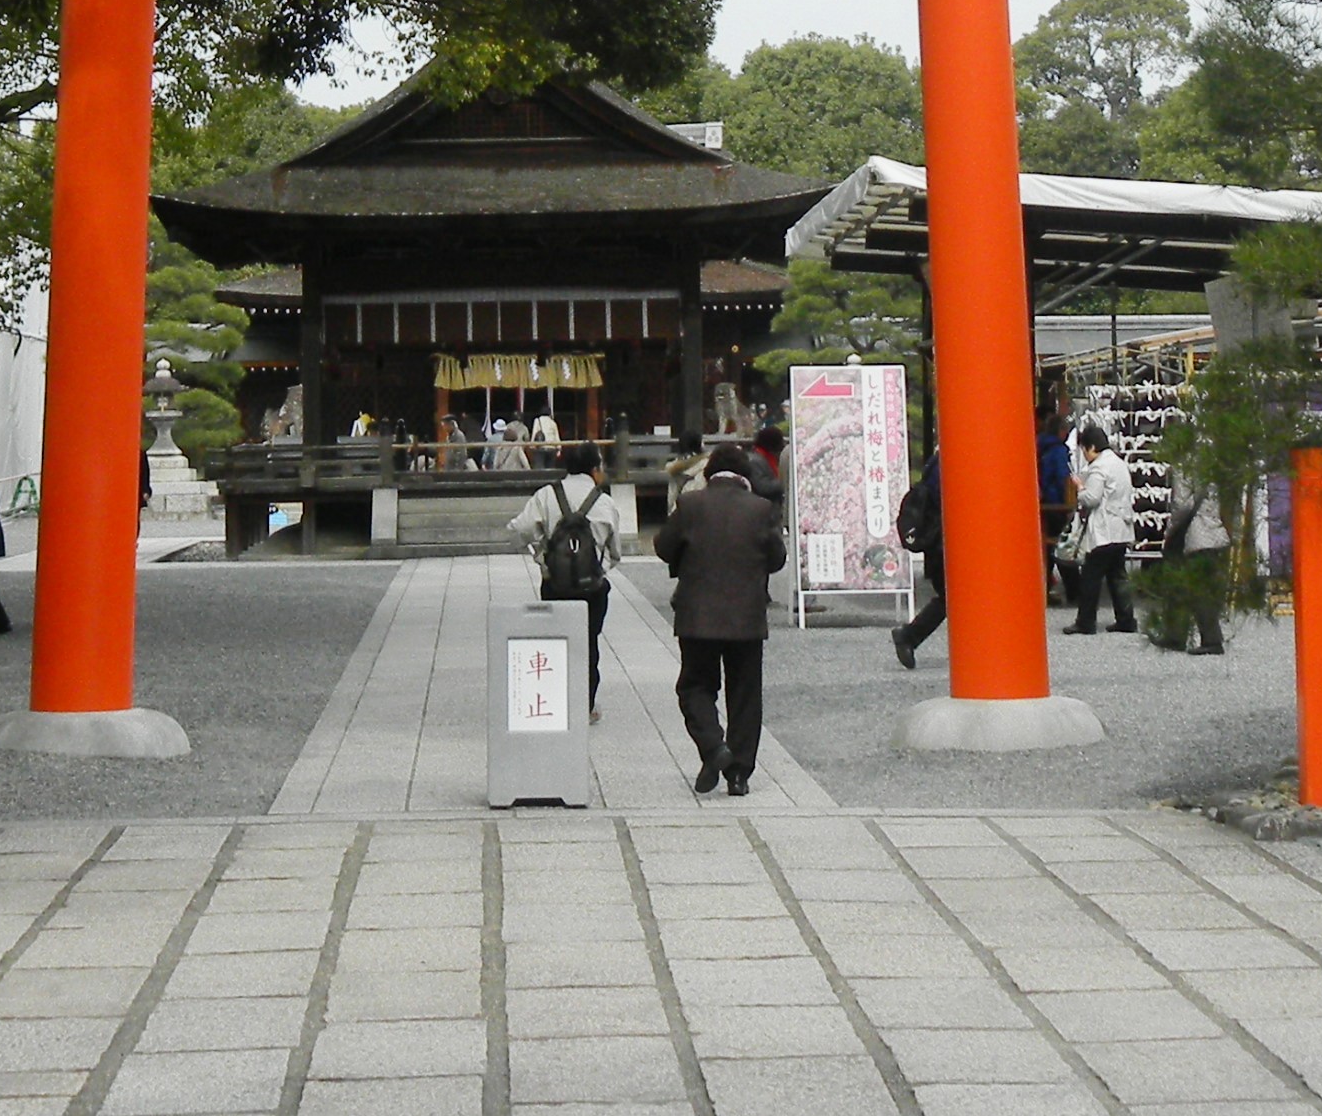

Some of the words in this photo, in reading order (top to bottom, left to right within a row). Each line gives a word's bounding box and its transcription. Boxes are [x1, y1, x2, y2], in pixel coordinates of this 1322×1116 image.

[867, 373, 885, 532] しだれ梅と椿まつり
[526, 651, 553, 717] 車止
